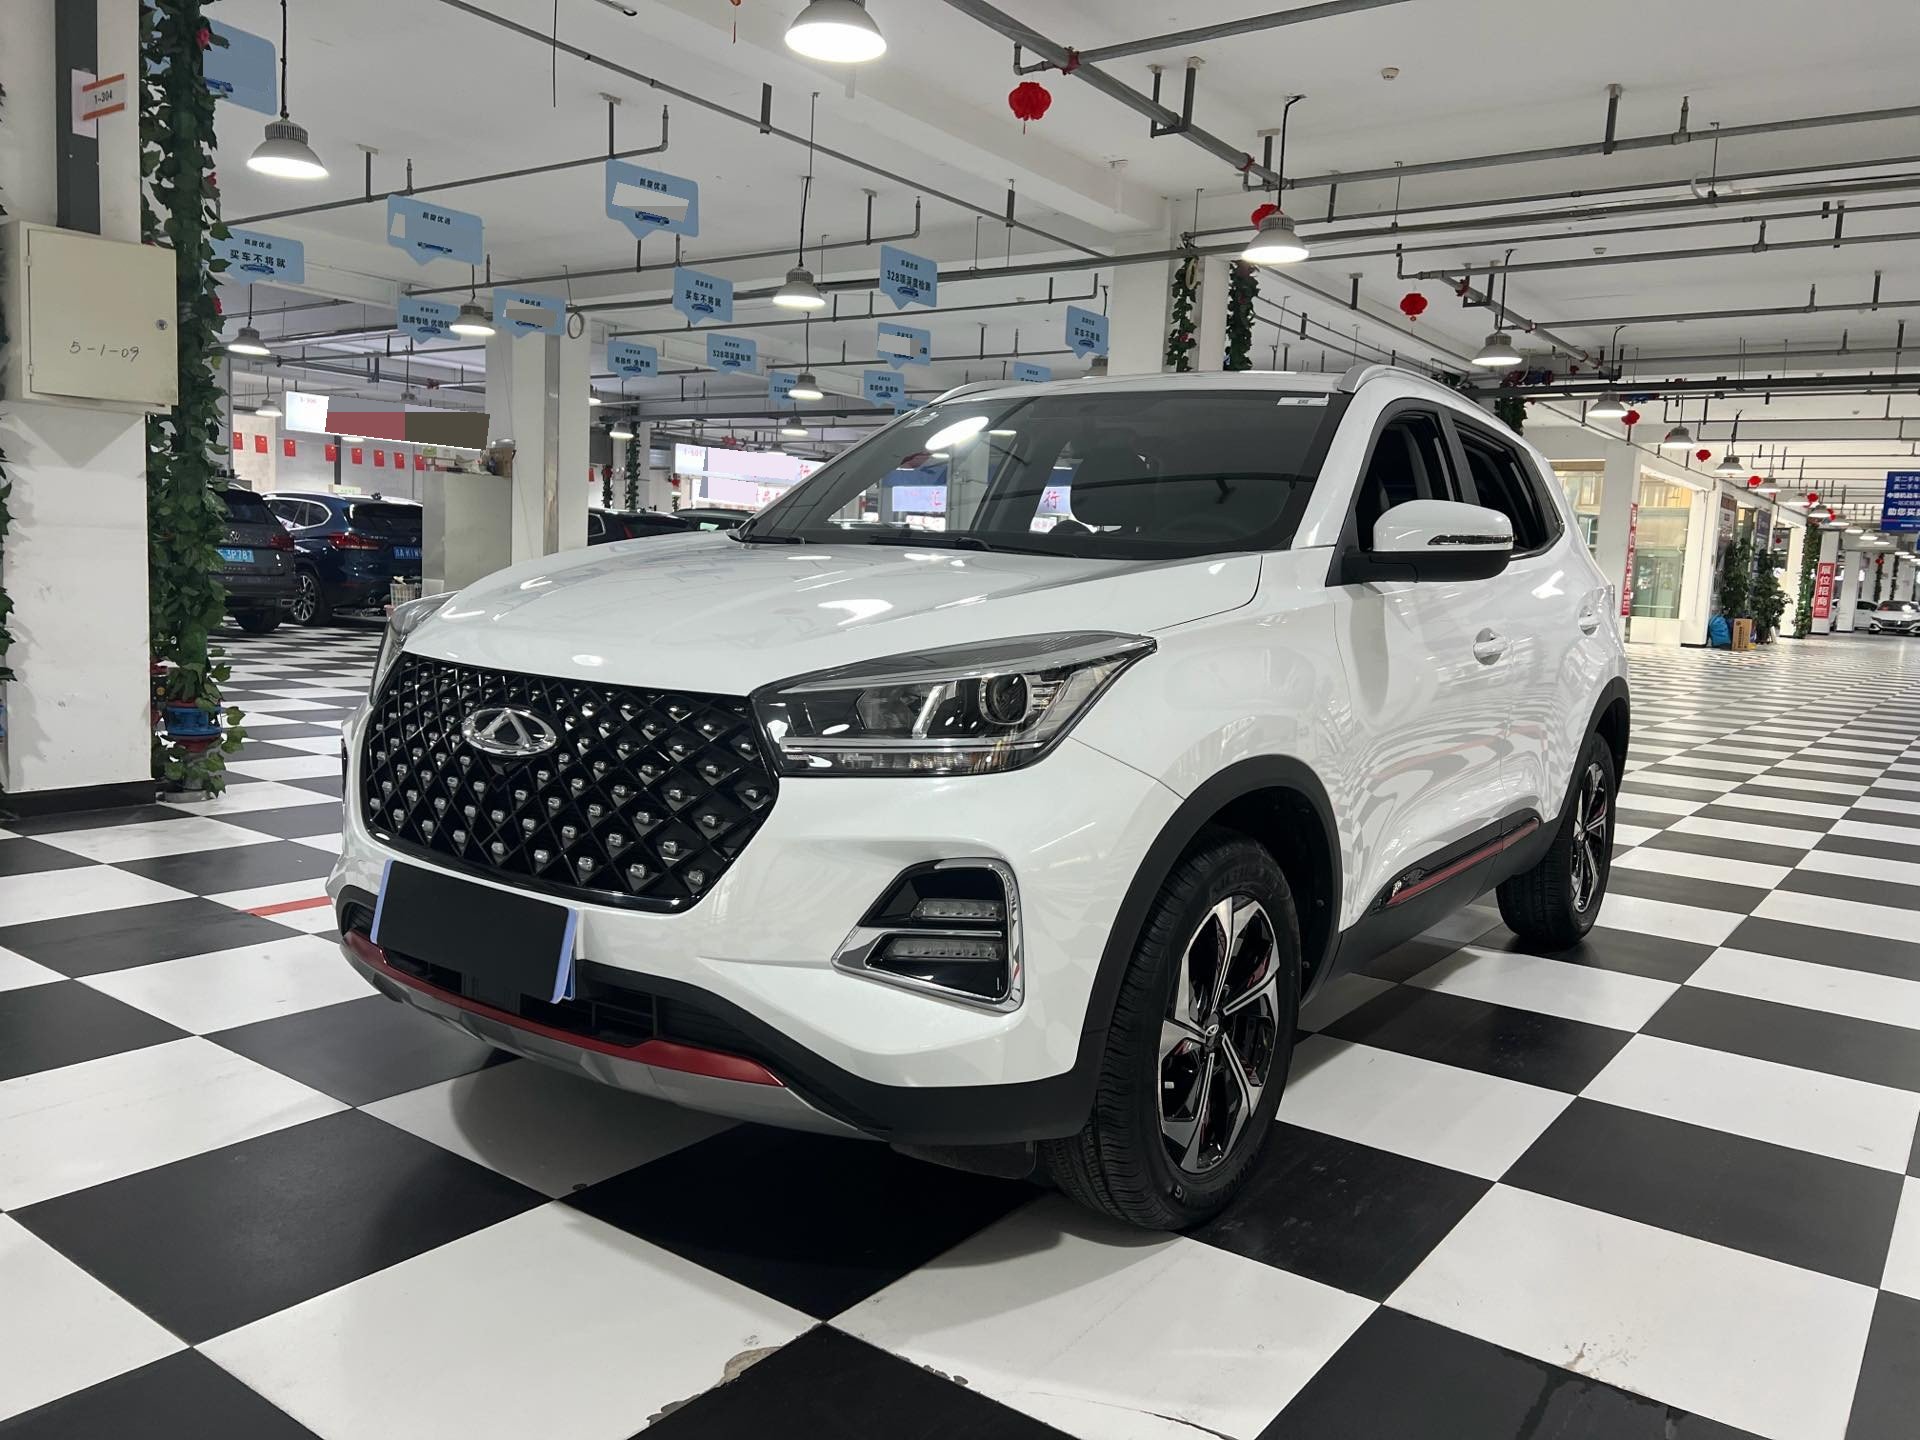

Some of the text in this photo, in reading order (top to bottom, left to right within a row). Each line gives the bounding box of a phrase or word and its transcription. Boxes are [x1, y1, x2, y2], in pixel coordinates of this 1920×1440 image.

[230, 249, 286, 269] 买车不将就
[887, 269, 931, 292] 328项深度检测
[685, 289, 721, 308] 买车不将就
[69, 340, 139, 363] 5-1-09
[1817, 565, 1832, 607] 展位招商
